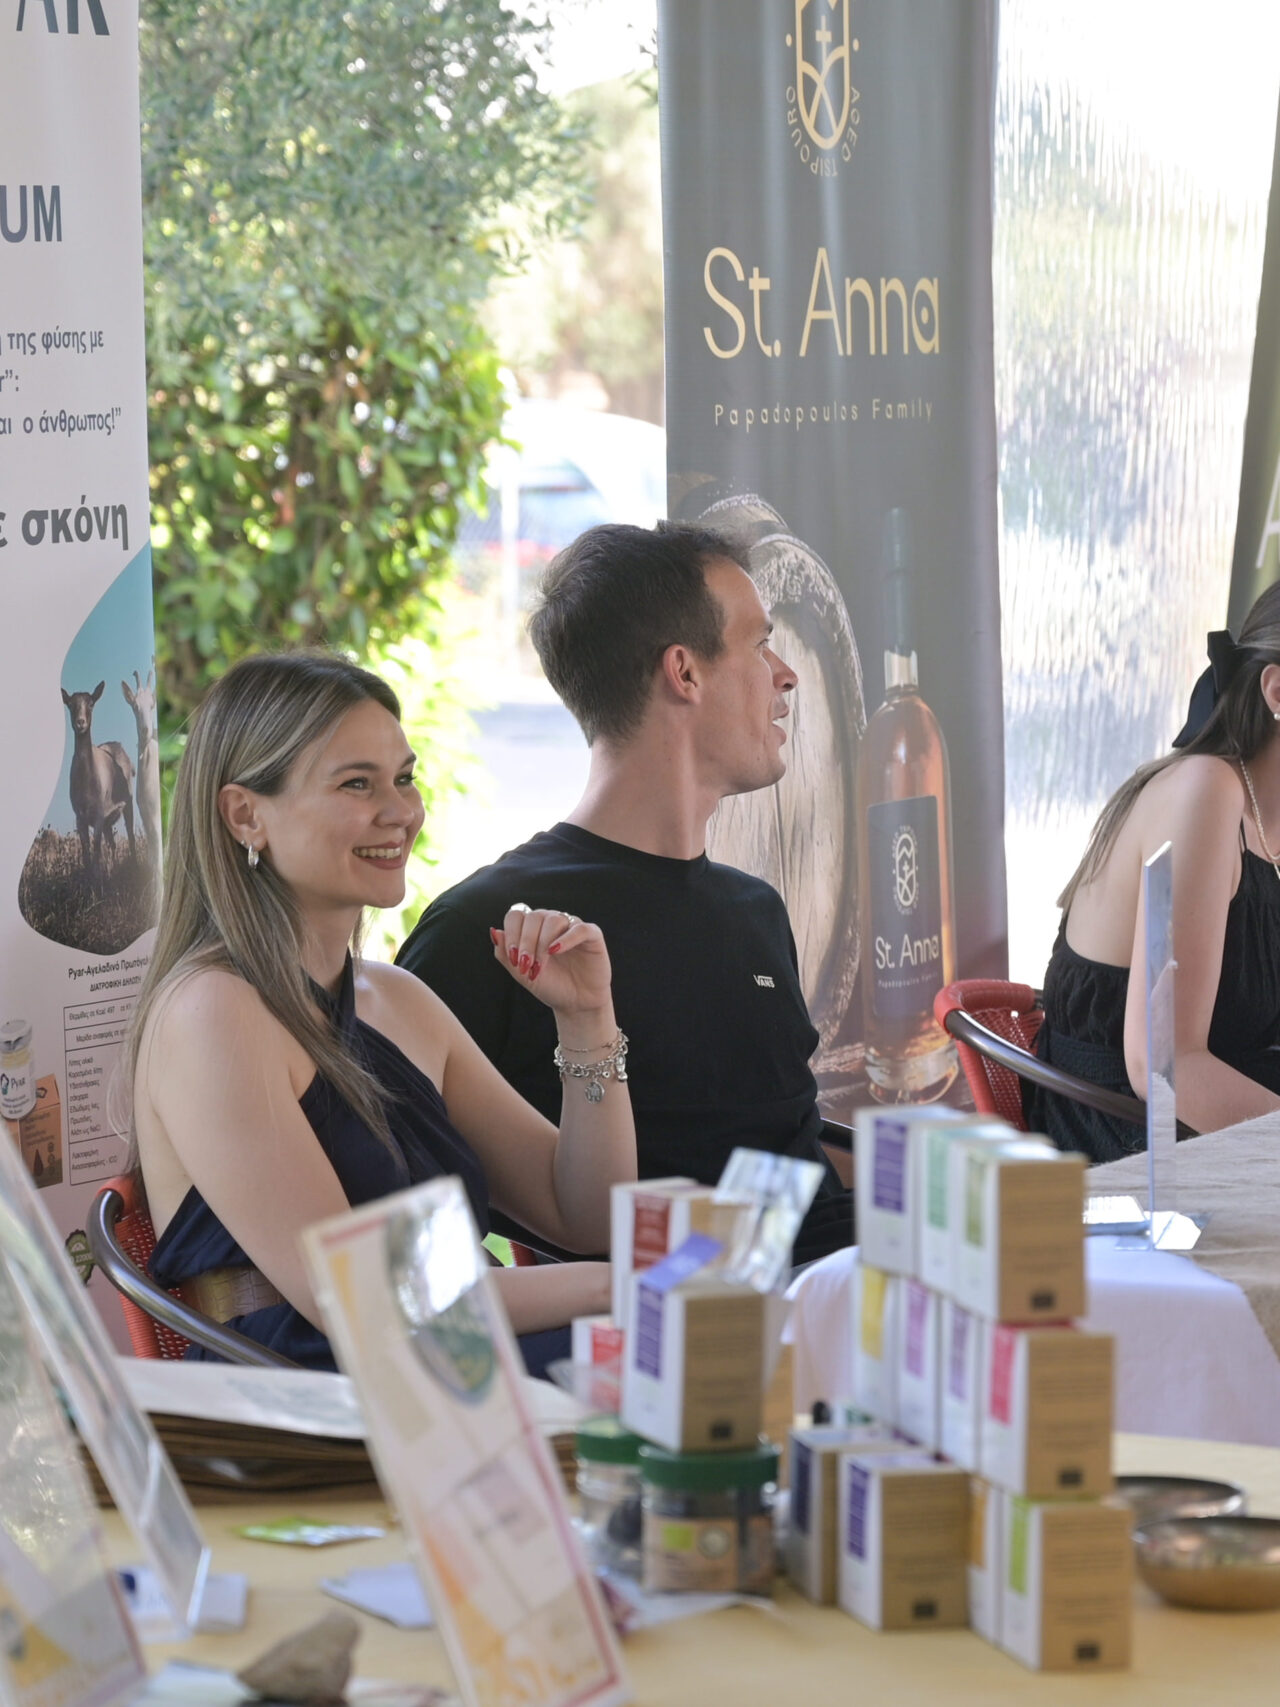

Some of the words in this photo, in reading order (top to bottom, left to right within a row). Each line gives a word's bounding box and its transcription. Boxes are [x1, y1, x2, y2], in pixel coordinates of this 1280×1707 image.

[785, 86, 838, 177] TSIPOURO
[703, 247, 781, 359] St.
[799, 247, 940, 356] Anna
[7, 332, 37, 356] της
[41, 325, 87, 355] φύσης
[90, 330, 104, 353] με
[39, 407, 121, 437] άνθρωπος!”
[715, 401, 858, 432] Papadopoulos
[872, 397, 933, 422] Family
[22, 495, 129, 551] σκόνη
[875, 936, 895, 969] St.
[899, 933, 939, 968] Anna
[753, 974, 775, 988] VANS
